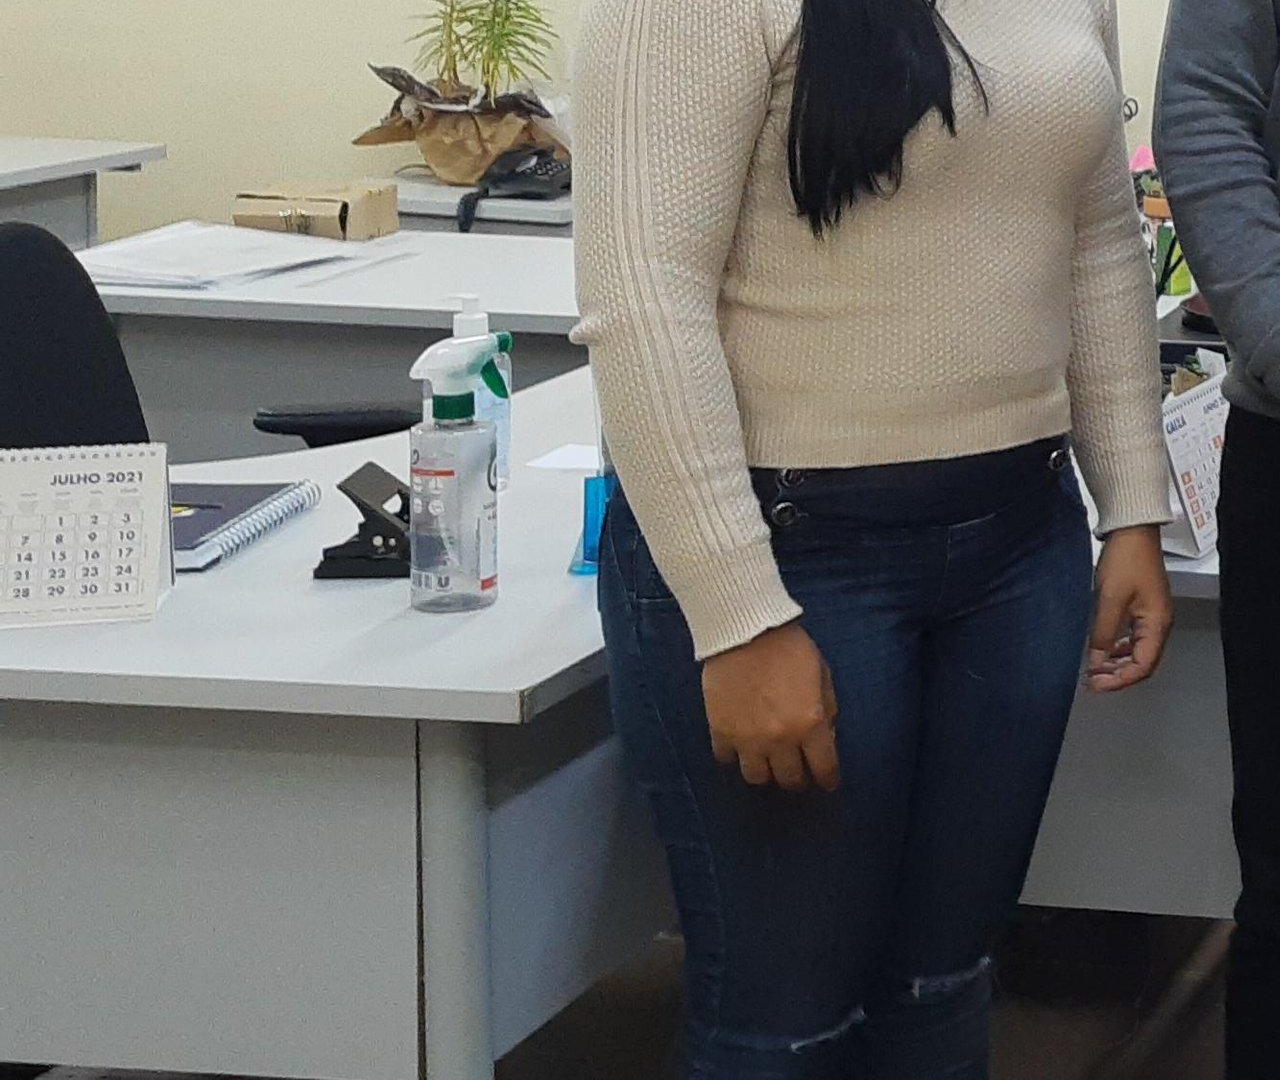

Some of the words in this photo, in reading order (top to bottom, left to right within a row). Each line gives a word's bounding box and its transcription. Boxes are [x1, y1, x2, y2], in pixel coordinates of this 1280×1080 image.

[50, 473, 101, 487] JULHO
[106, 471, 144, 484] 2021
[58, 516, 63, 527] 1
[90, 515, 98, 525] 2
[122, 513, 131, 524] 3
[88, 531, 97, 542] 9
[119, 530, 135, 541] 10
[17, 552, 33, 562] 14
[51, 551, 67, 562] 15
[84, 549, 100, 561] 16
[117, 547, 133, 558] 17
[14, 569, 30, 580] 21
[48, 568, 66, 579] 22
[115, 565, 132, 576] 24
[13, 587, 30, 598] 28
[47, 585, 65, 597] 29
[80, 583, 98, 595] 30
[114, 582, 130, 593] 31
